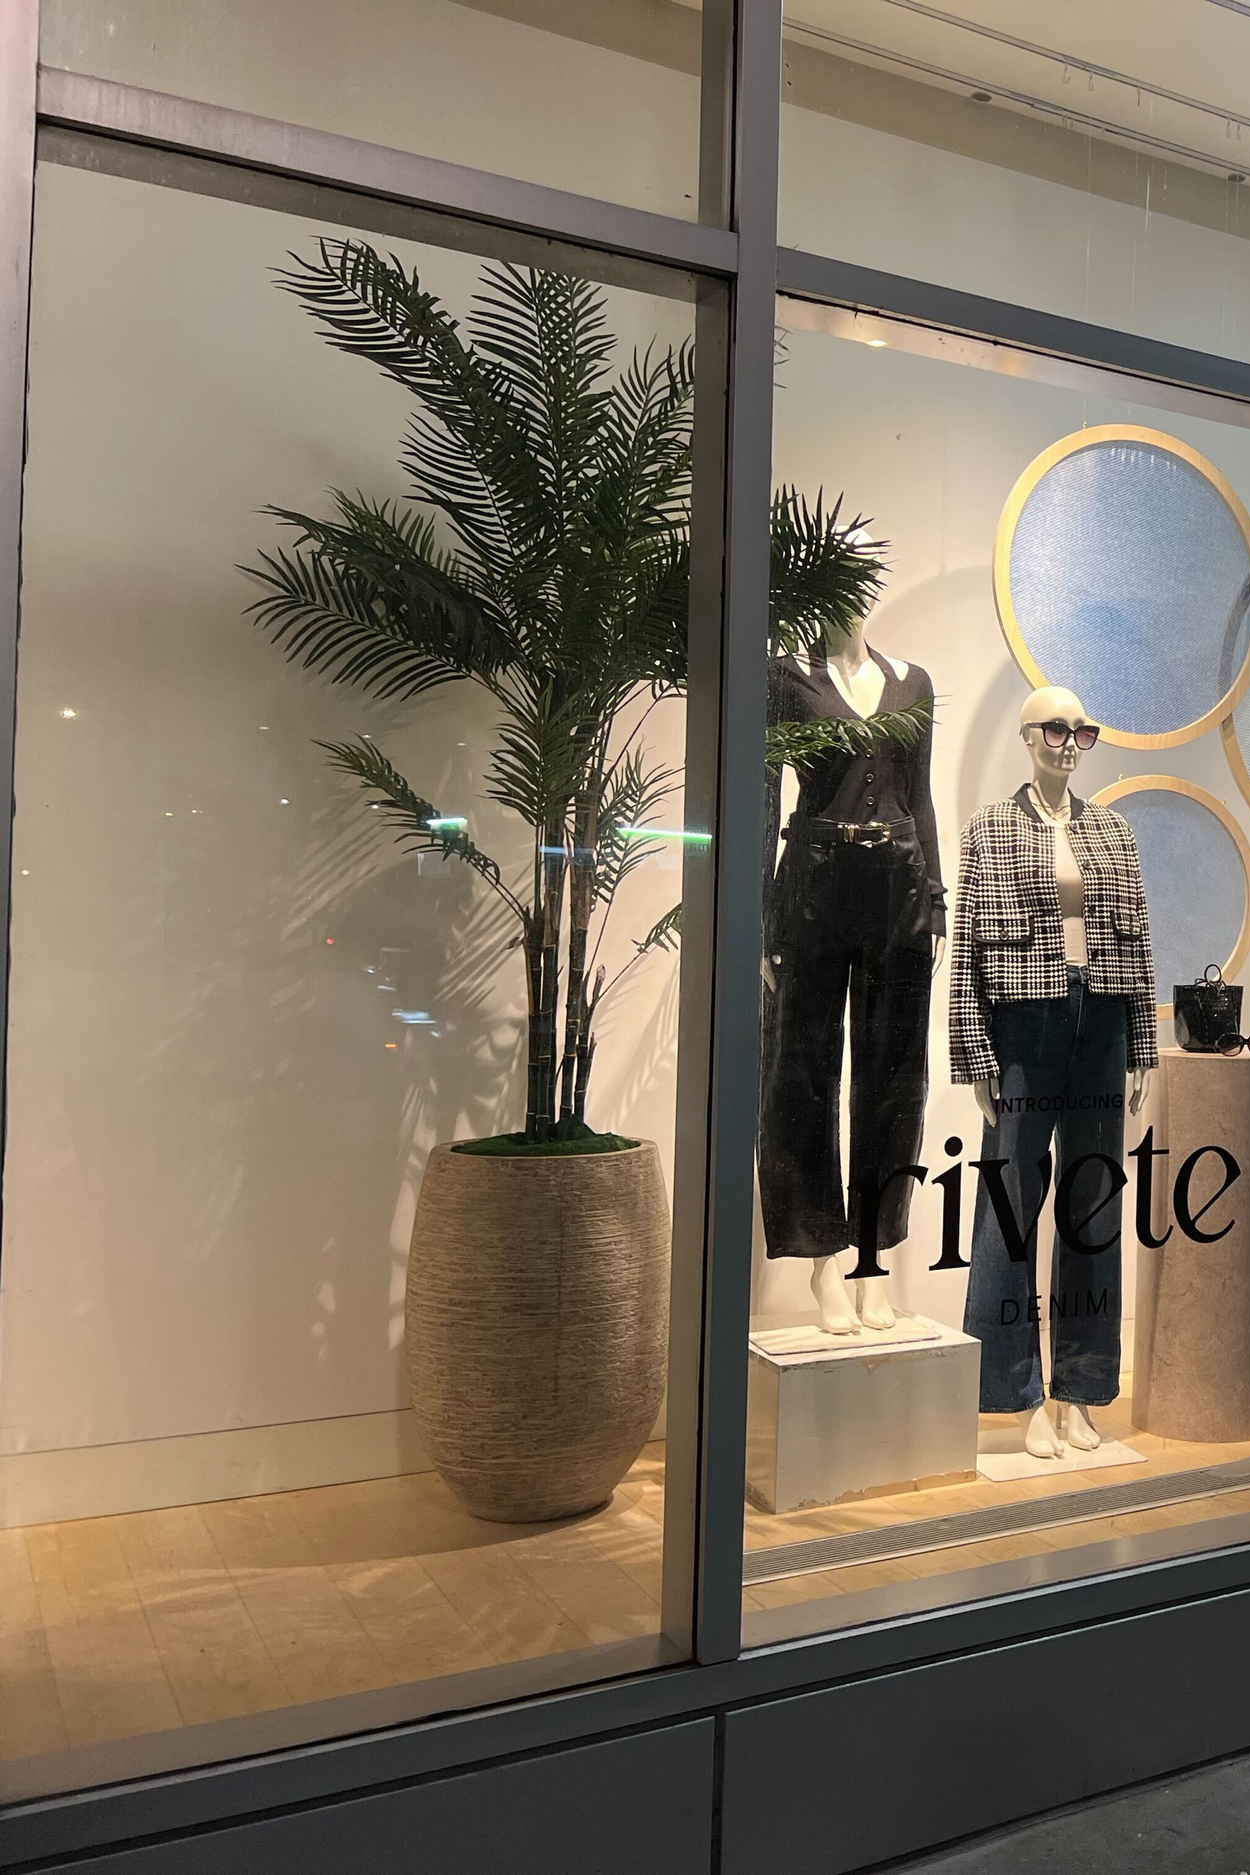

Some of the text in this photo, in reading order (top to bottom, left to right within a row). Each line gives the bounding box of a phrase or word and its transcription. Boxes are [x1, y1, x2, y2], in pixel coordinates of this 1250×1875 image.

[995, 1094, 1123, 1114] INTRODUCING
[844, 1125, 1241, 1280] rivete
[1001, 1288, 1107, 1325] DENIM
